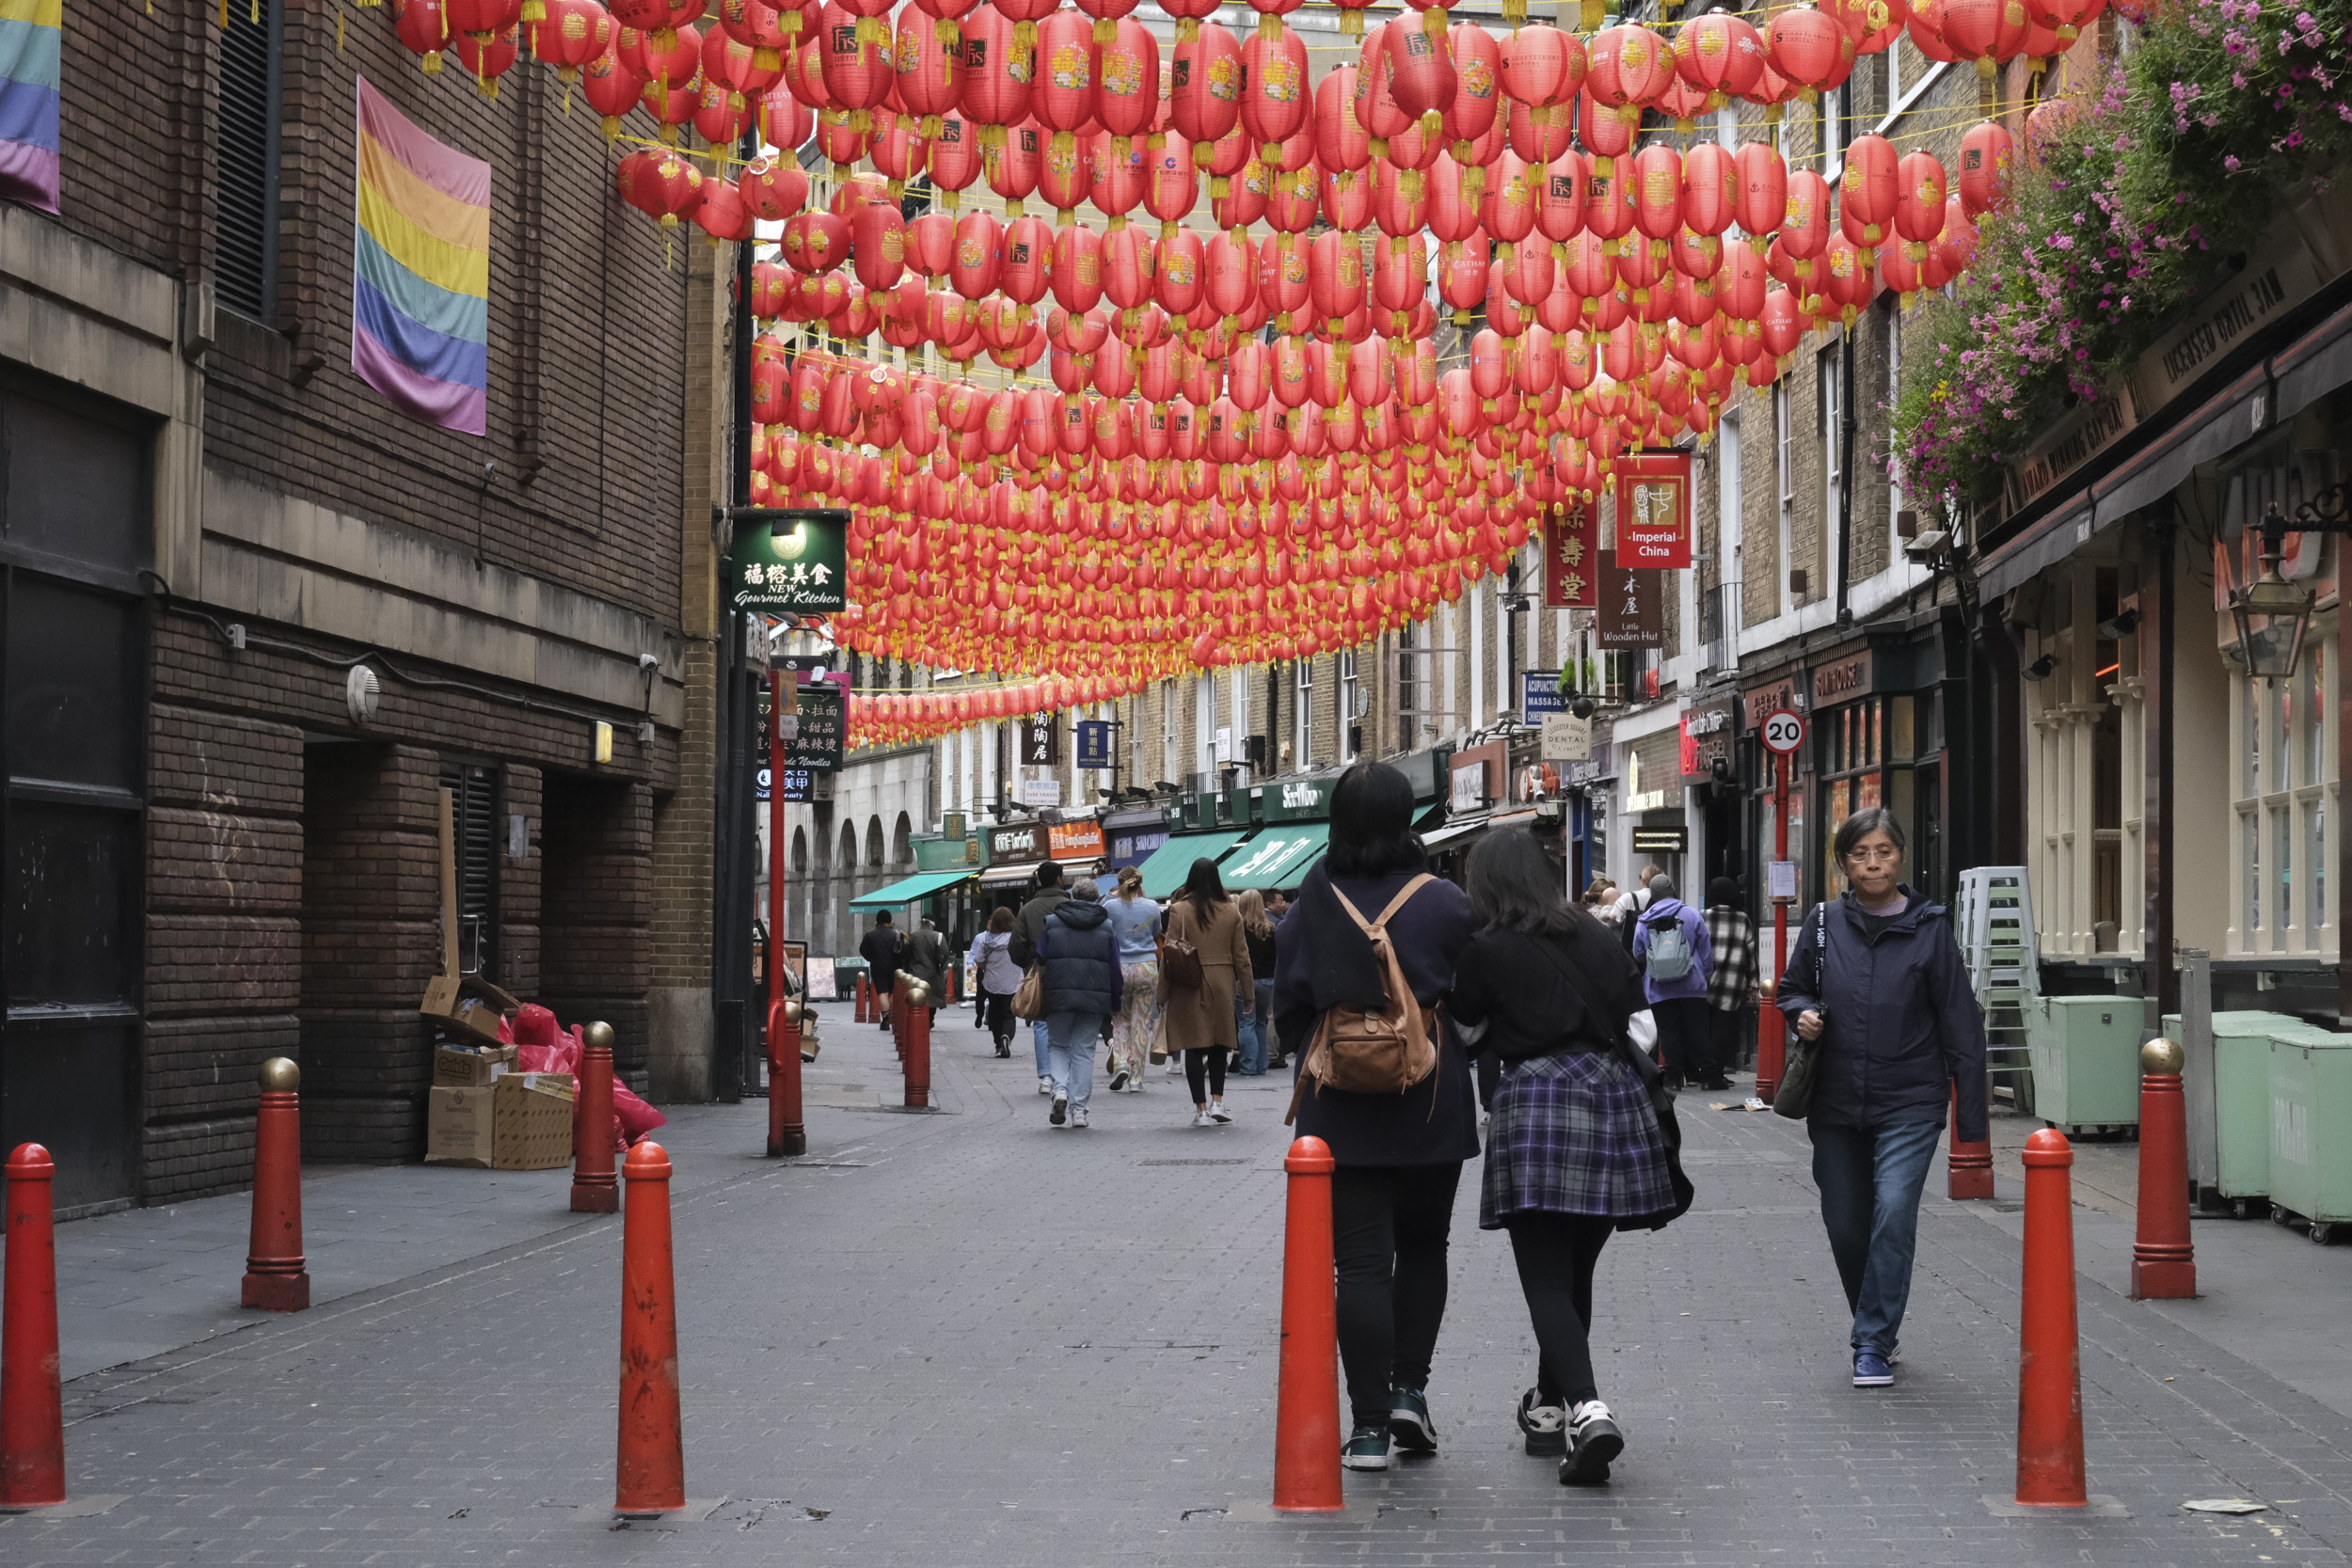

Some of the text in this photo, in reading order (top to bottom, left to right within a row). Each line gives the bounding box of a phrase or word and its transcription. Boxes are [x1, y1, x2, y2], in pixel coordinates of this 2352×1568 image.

[1632, 531, 1677, 542] Imperial
[1639, 546, 1670, 557] China
[768, 584, 798, 594] NEW
[1620, 568, 1642, 615] 木屋
[734, 590, 841, 607] Gourmet Kitchen
[1622, 622, 1640, 631] Little
[1603, 630, 1659, 641] Wooden Hut
[1528, 680, 1561, 692] ACUPUNCTUR
[1528, 697, 1562, 705] MASSAGE
[1033, 711, 1048, 760] 陶陶居
[1768, 722, 1800, 741] 20
[798, 756, 831, 767] Noodles
[784, 778, 808, 789] 美甲
